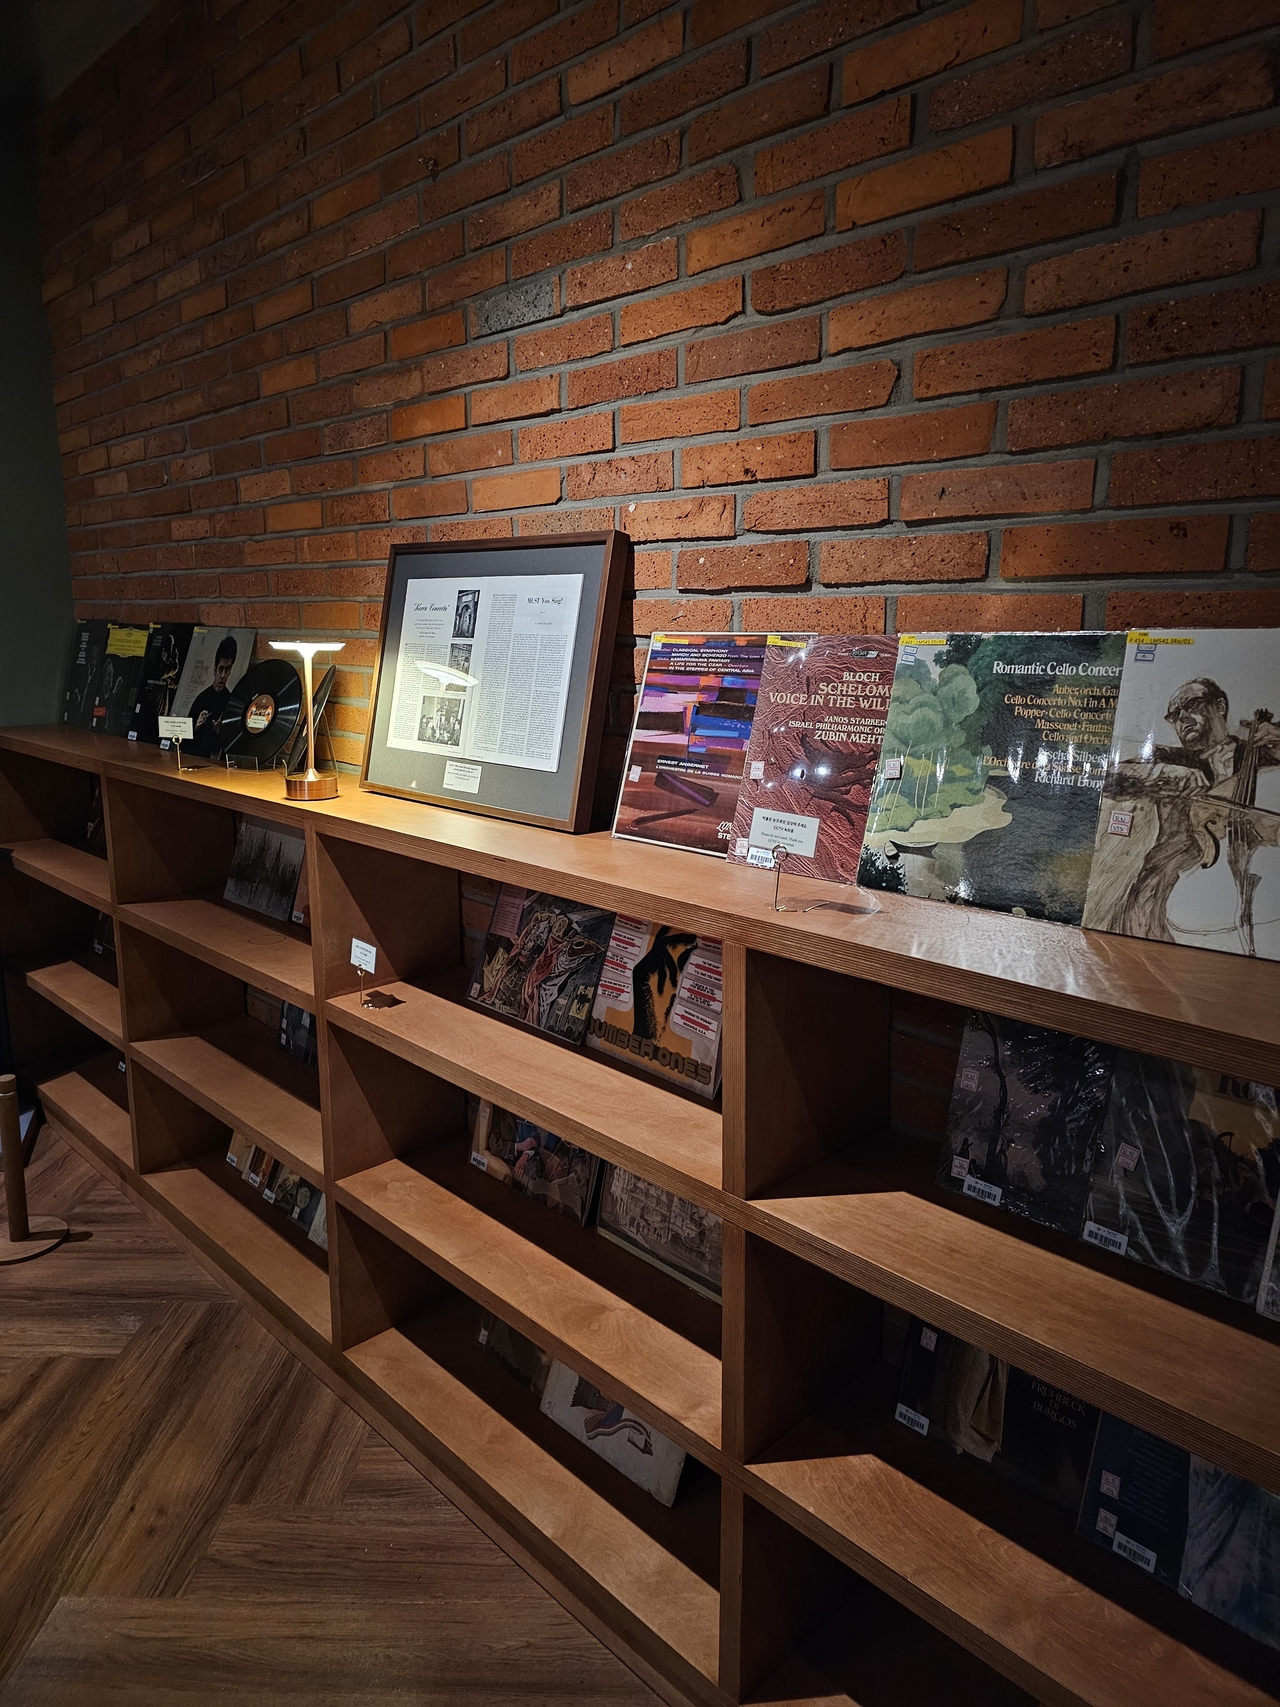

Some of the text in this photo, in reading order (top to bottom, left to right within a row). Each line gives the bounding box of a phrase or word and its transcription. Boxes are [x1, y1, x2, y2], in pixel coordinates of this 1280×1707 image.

[992, 660, 1045, 675] Romantic
[1046, 662, 1076, 675] Cello
[843, 672, 880, 682] BLOCH
[769, 692, 807, 705] VOICE
[810, 695, 824, 706] IN
[828, 696, 855, 708] THE
[1004, 694, 1025, 705] Cello
[1027, 694, 1067, 706] Concerto
[1089, 698, 1098, 708] in
[1099, 698, 1107, 708] A
[1049, 708, 1072, 718] Cello
[1074, 708, 1114, 720] Concerto
[789, 720, 814, 728] ISRAEL
[815, 722, 872, 733] PHILHARMONIC
[814, 731, 847, 742] ZUBIN
[1042, 731, 1064, 741] Cello
[1066, 733, 1082, 742] and
[1034, 771, 1074, 786] Richard
[658, 1046, 712, 1085] ONES
[1050, 1400, 1062, 1412] DE
[1033, 1401, 1078, 1429] BURGOS
